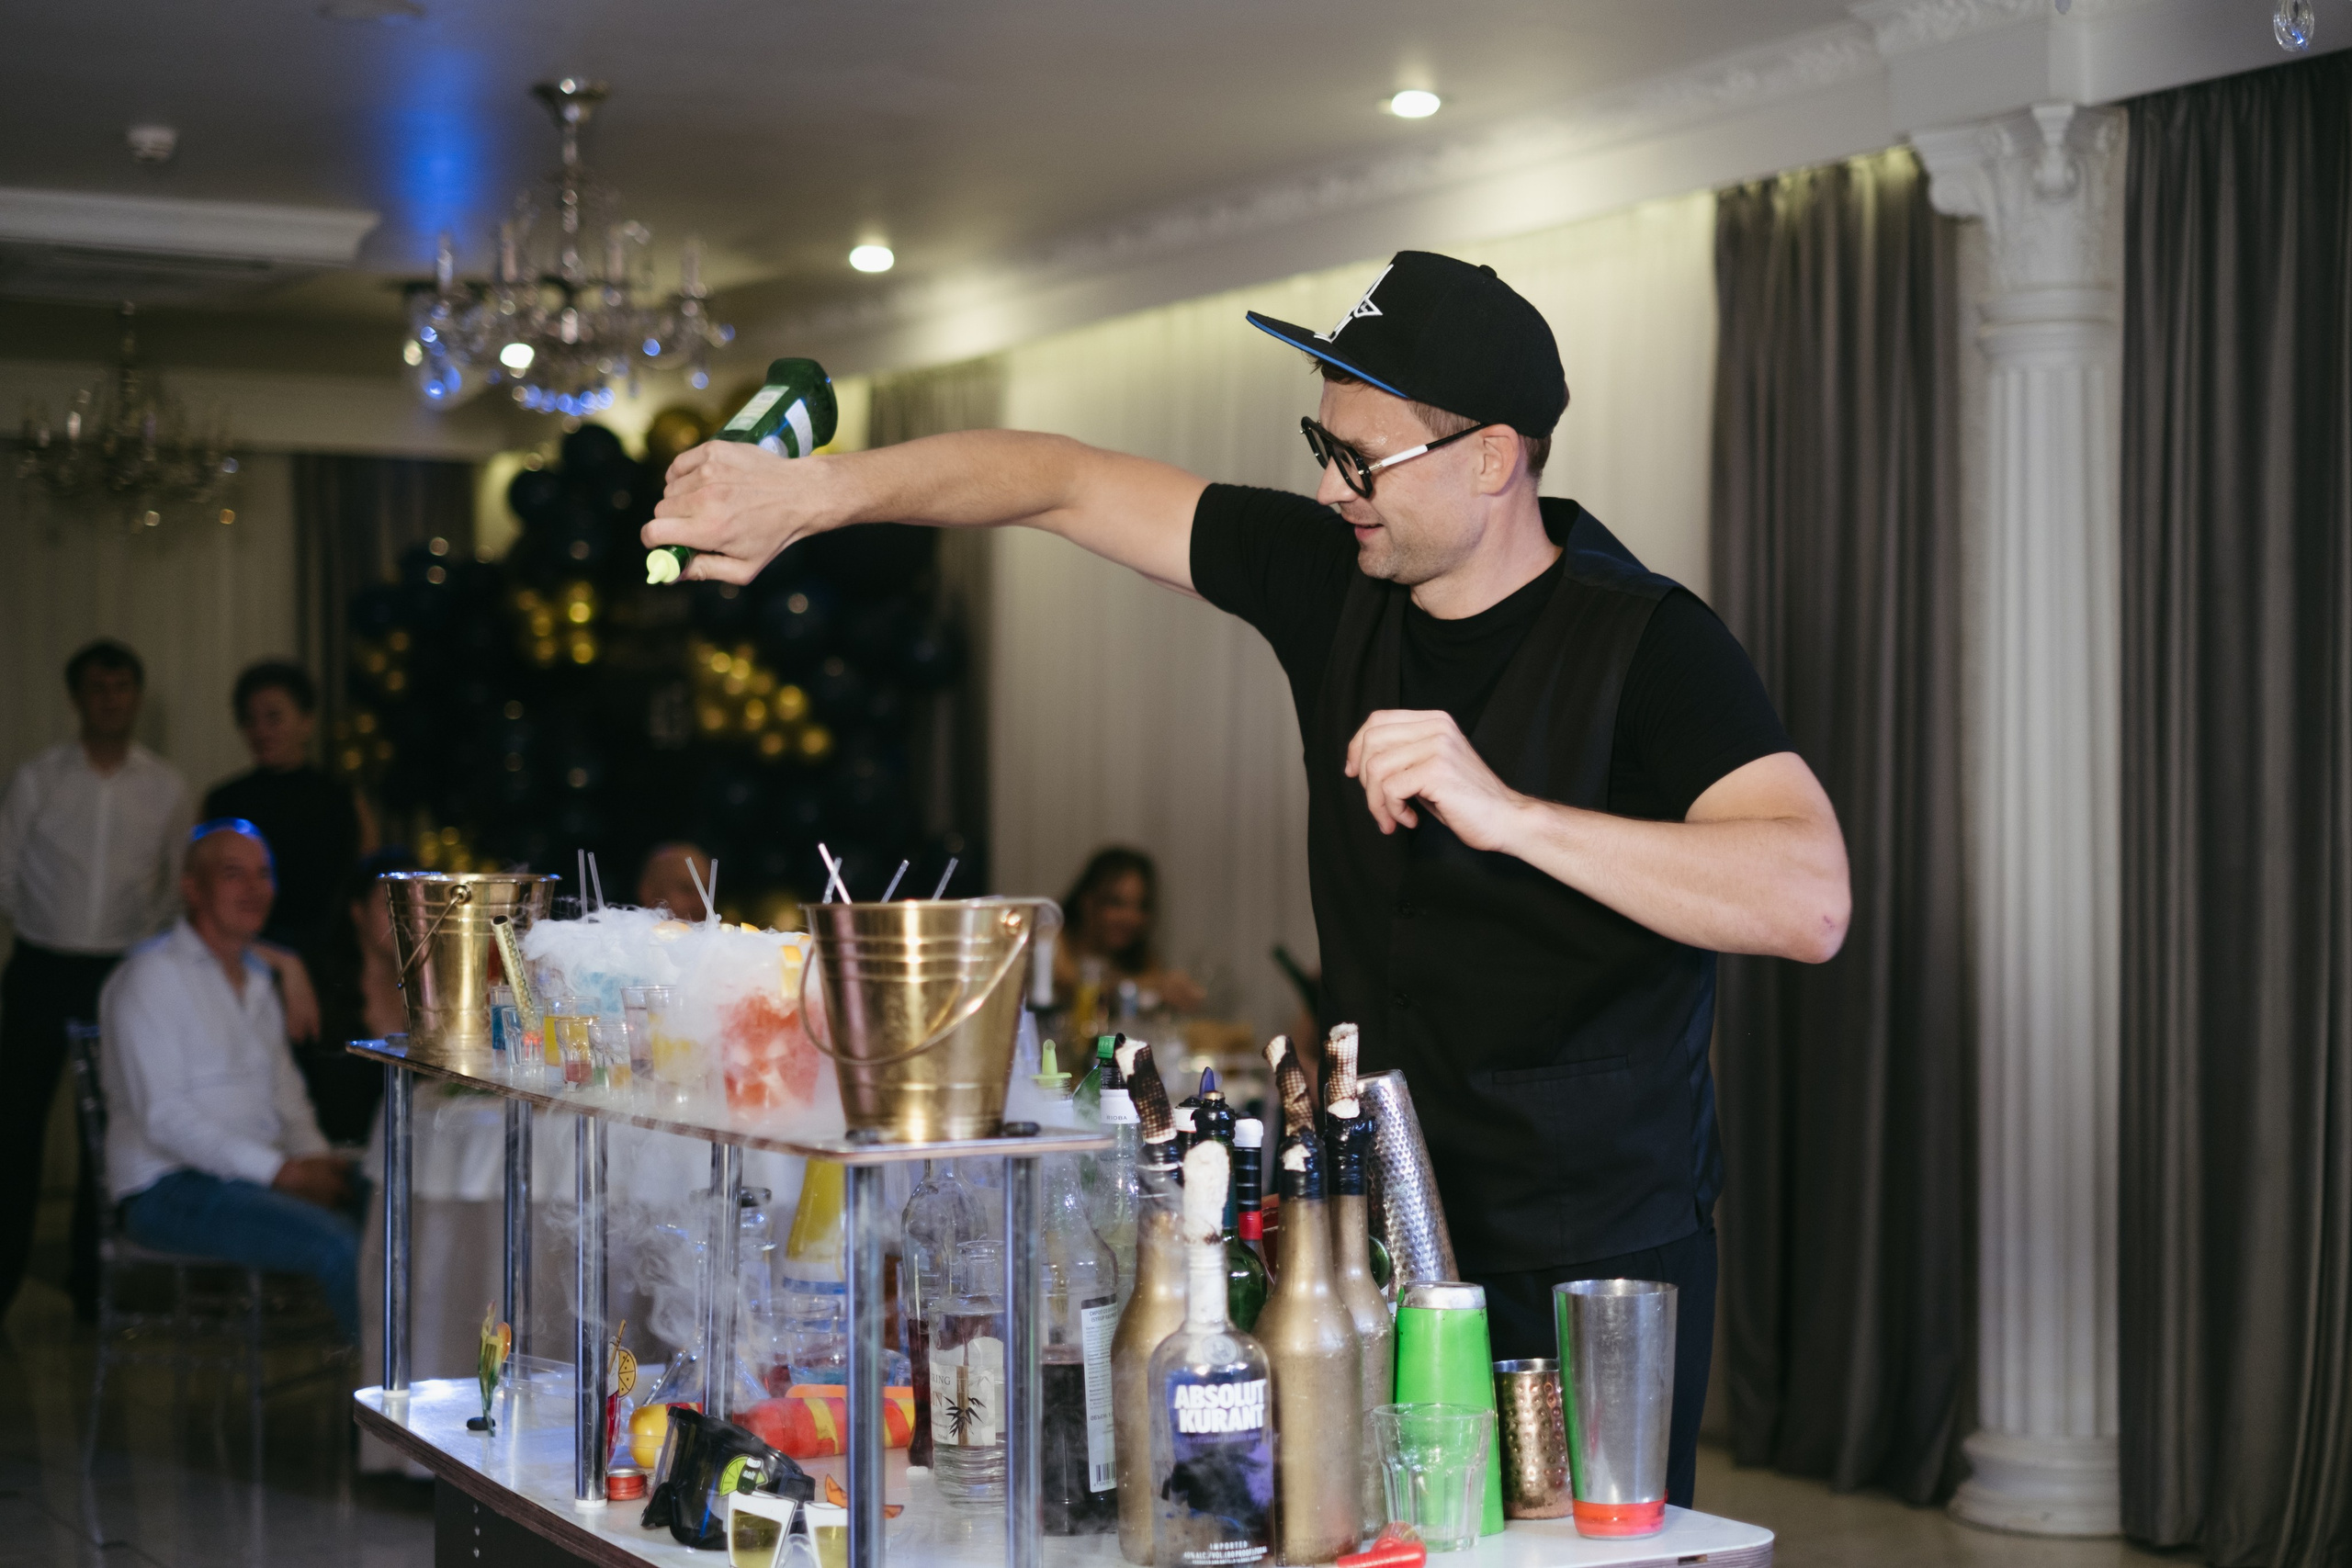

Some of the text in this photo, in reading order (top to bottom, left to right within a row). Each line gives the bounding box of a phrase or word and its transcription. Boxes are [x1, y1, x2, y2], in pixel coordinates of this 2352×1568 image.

[1174, 1379, 1267, 1410] ABSOLUT
[1179, 1404, 1264, 1434] KURANT
[1209, 1540, 1248, 1551] IMPORTED
